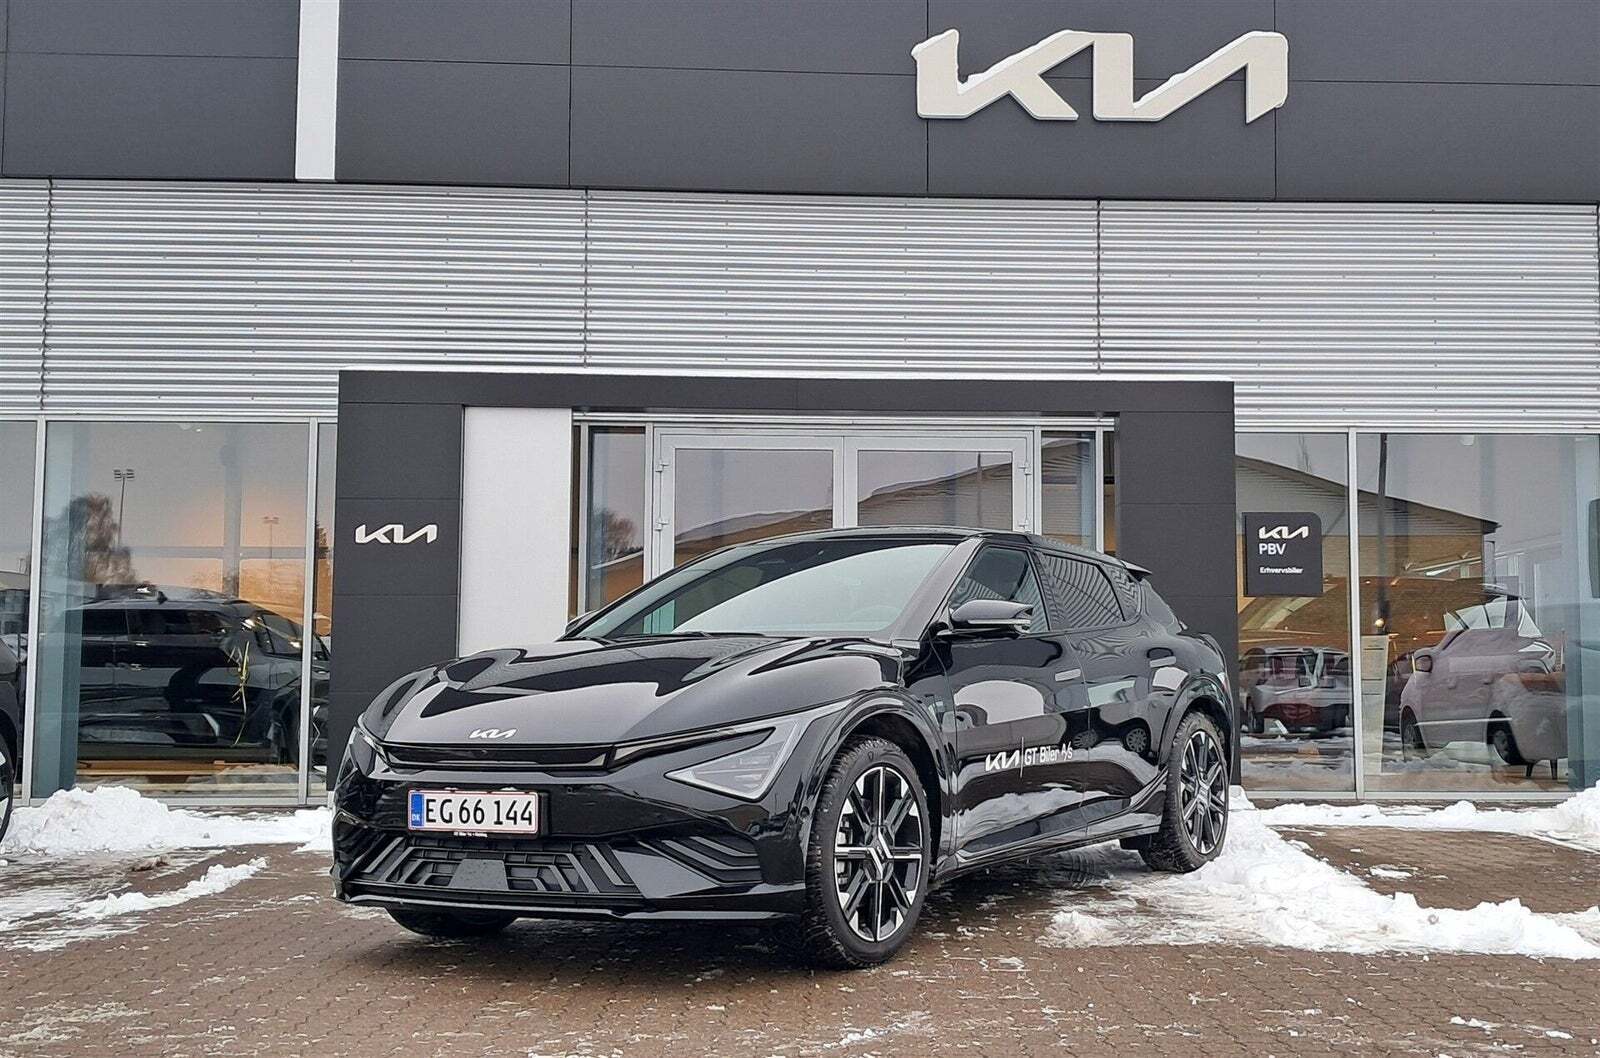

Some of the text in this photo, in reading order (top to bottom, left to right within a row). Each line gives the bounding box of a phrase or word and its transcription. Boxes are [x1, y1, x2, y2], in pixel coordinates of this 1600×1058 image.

[911, 29, 1289, 124] KIA
[355, 524, 438, 544] KIA
[1258, 526, 1309, 539] KIA
[1259, 543, 1286, 555] PBV
[1024, 747, 1038, 766] GT
[1039, 745, 1060, 763] Biler
[425, 798, 533, 826] EG 66 144
